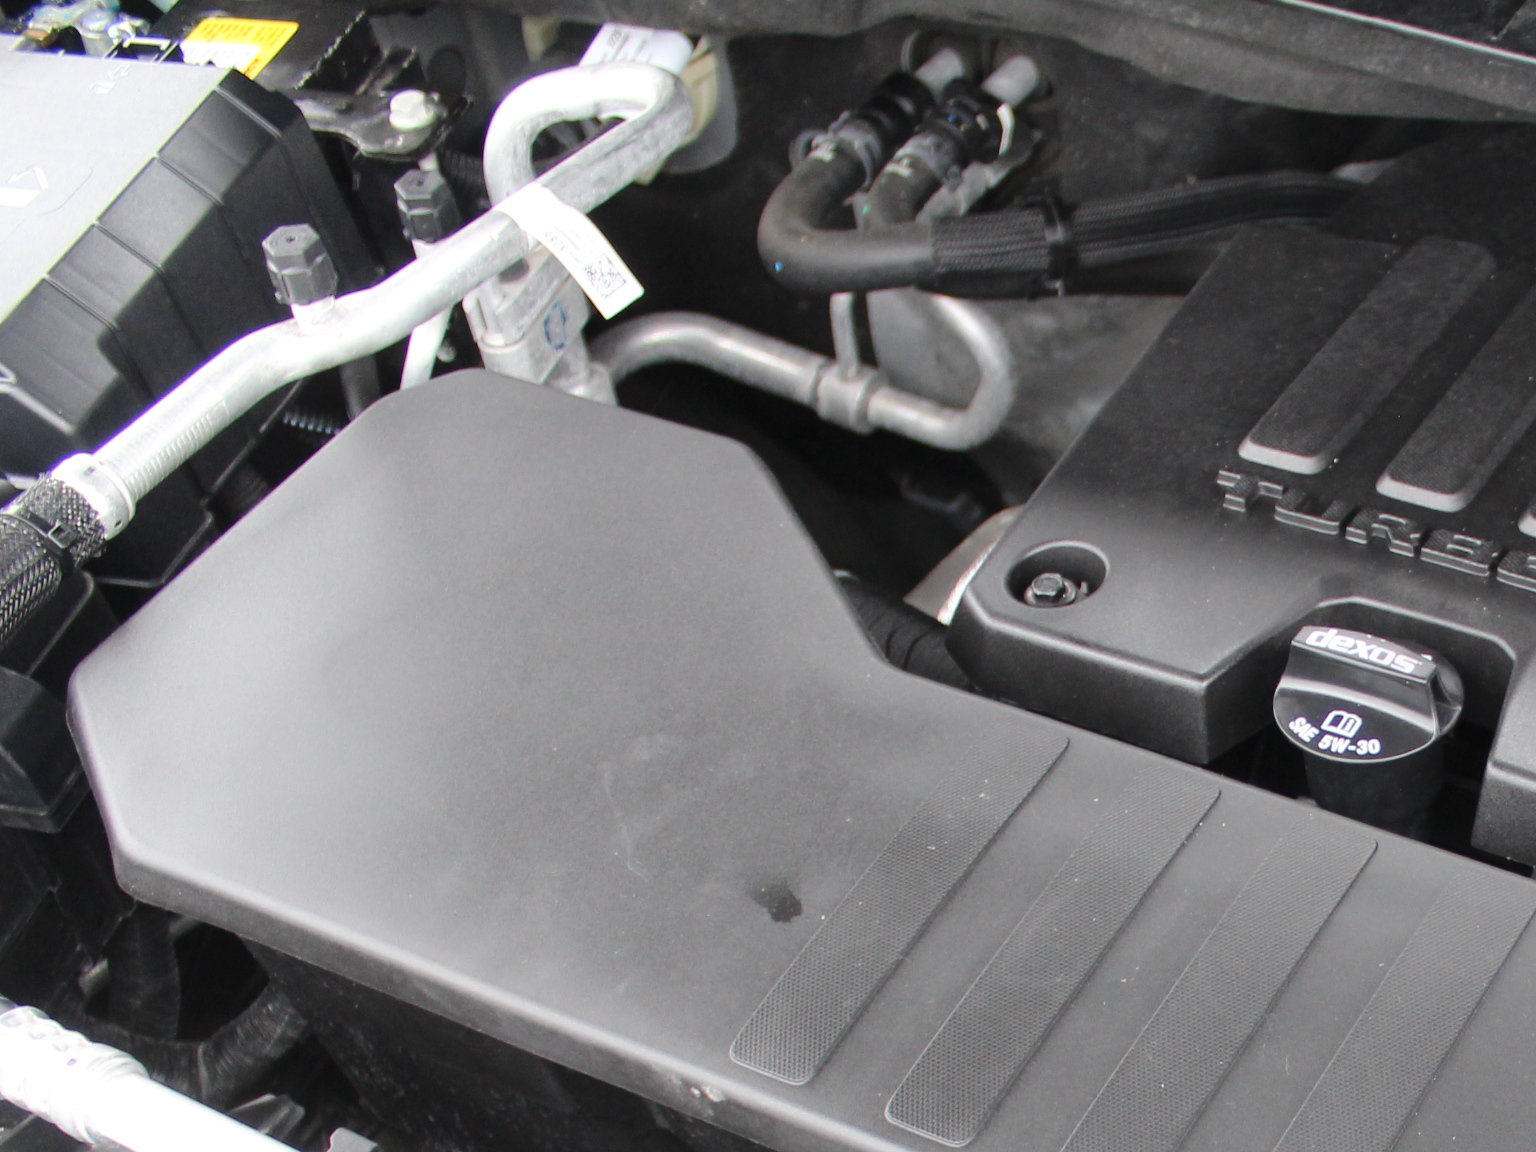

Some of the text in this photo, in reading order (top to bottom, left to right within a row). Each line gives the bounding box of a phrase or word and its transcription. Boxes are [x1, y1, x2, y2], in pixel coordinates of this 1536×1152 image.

[1305, 628, 1415, 674] dexos
[1288, 716, 1382, 756] SAE 5W-30
